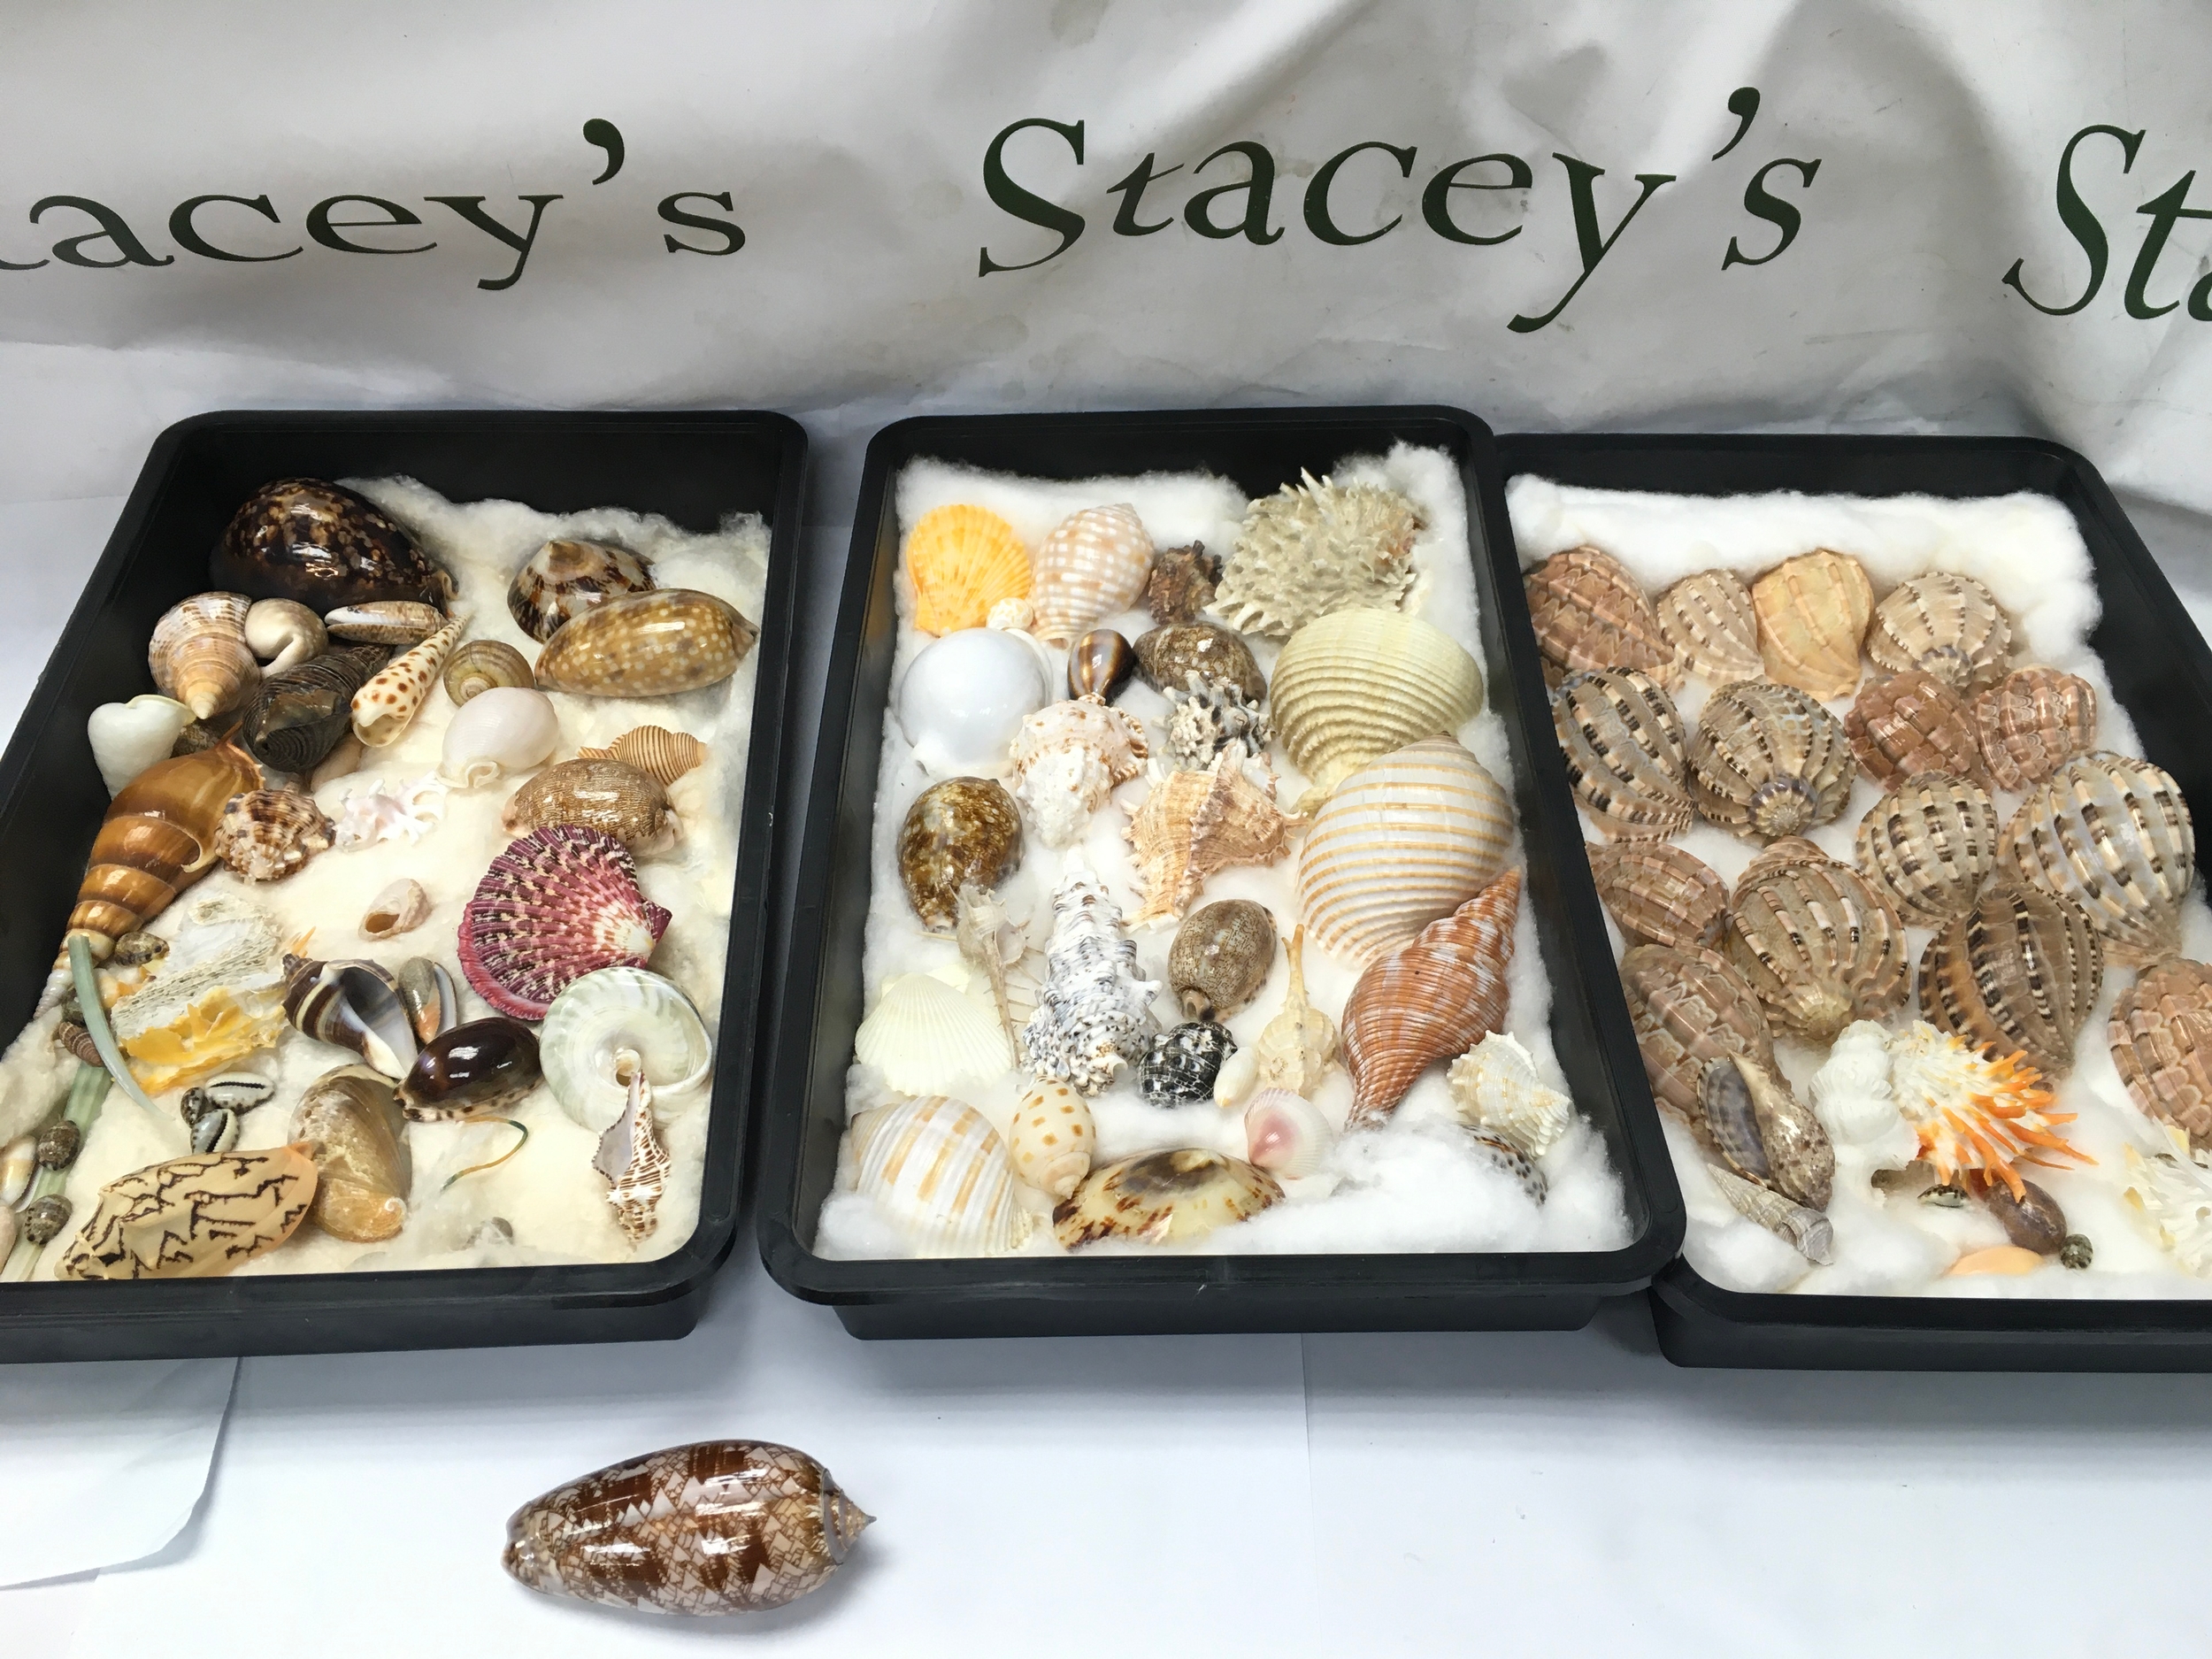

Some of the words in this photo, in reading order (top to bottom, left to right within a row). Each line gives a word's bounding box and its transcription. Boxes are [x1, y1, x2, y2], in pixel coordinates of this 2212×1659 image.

[0, 118, 747, 291] acey's
[979, 87, 1823, 334] Stacey's
[2001, 124, 2212, 322] St
